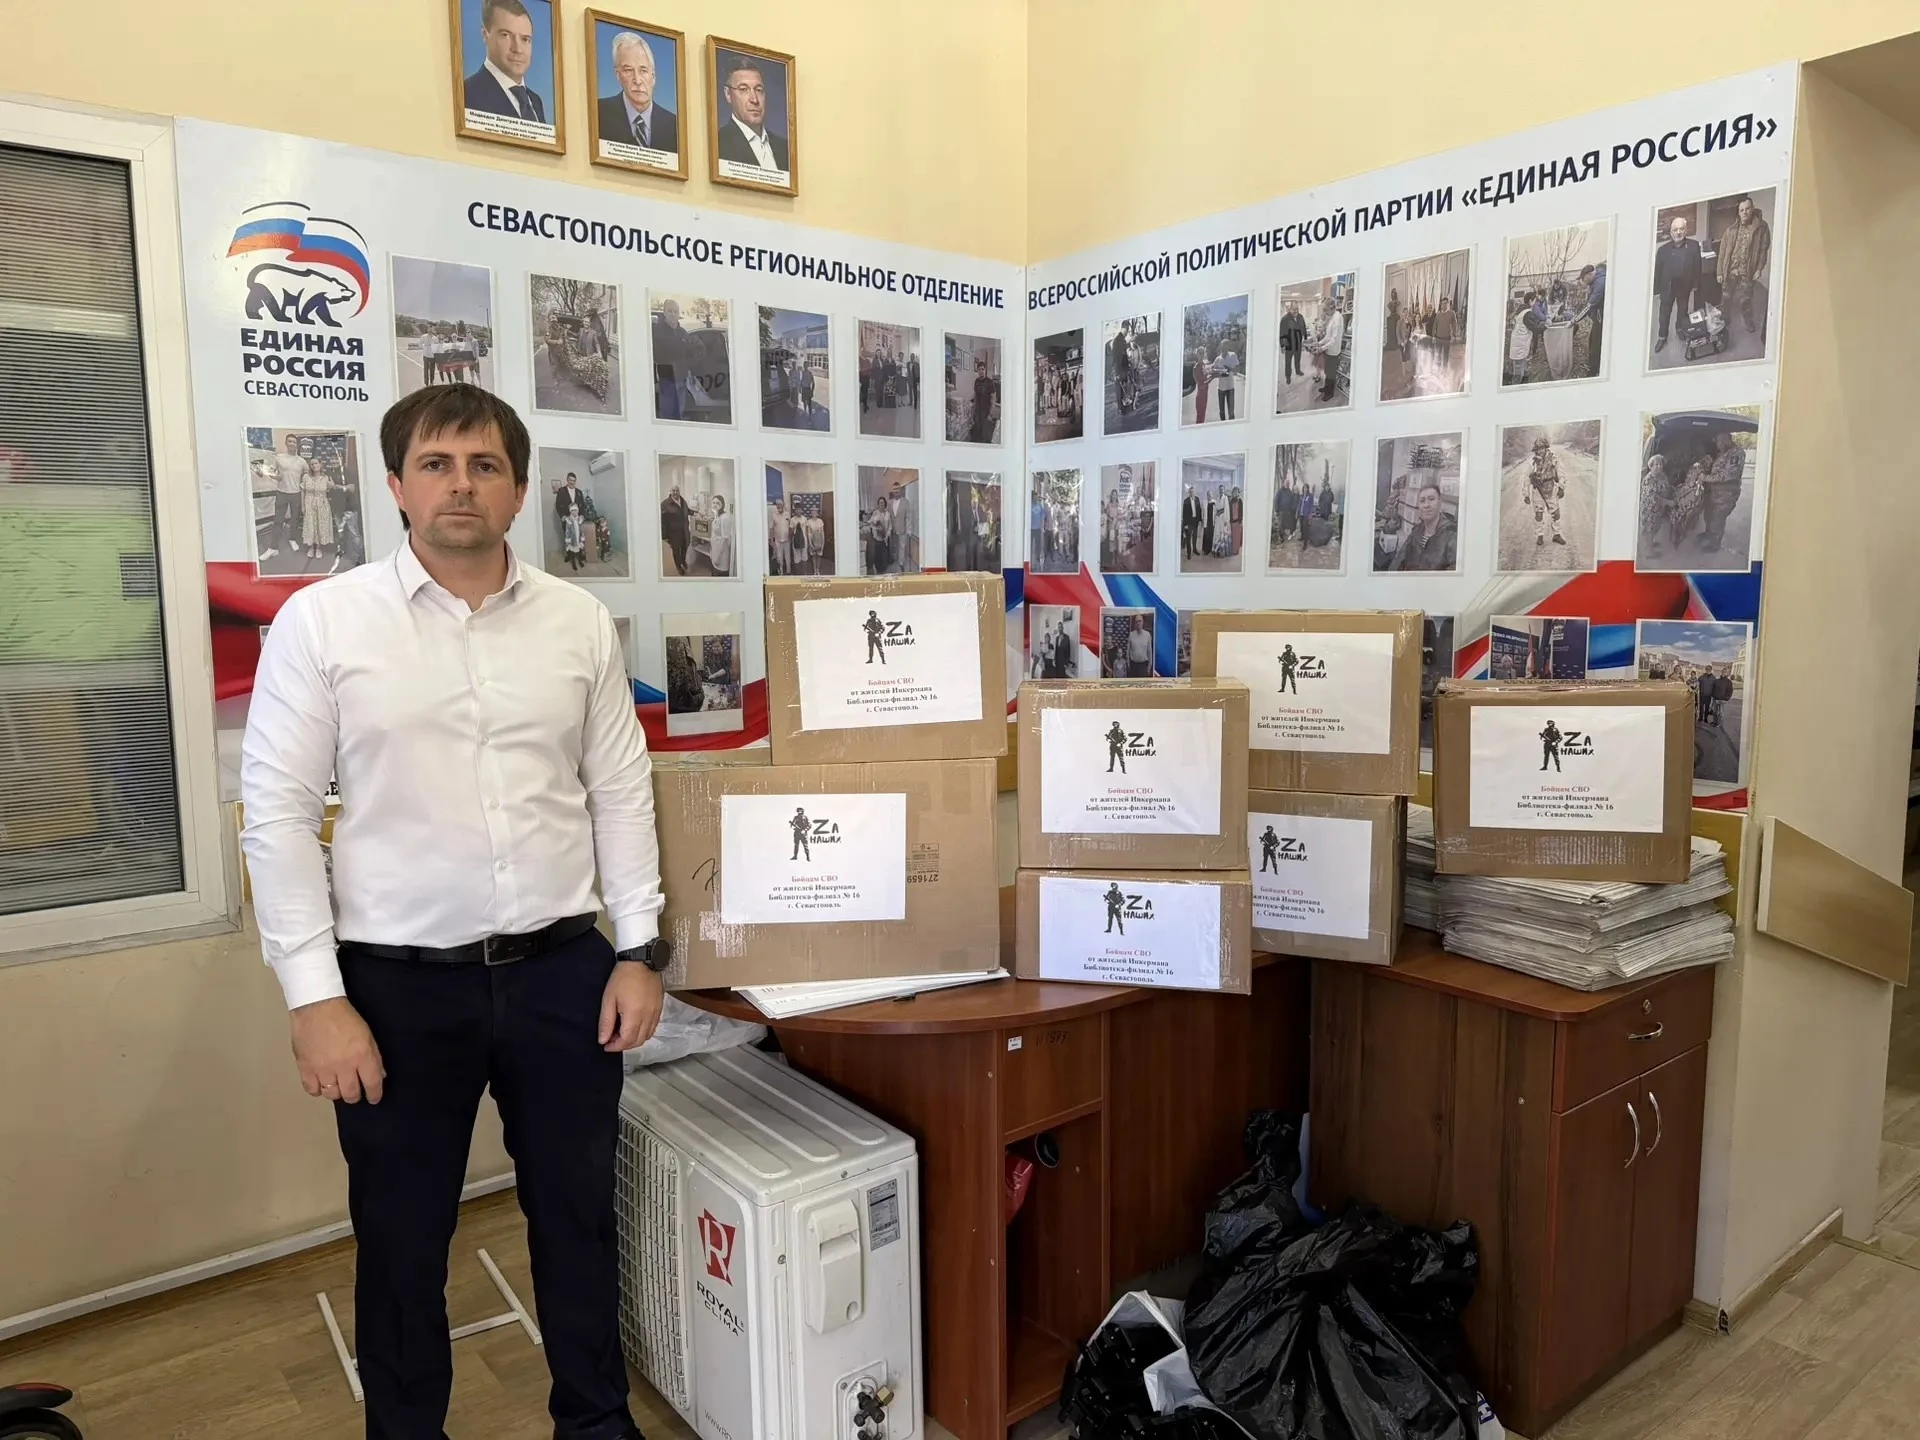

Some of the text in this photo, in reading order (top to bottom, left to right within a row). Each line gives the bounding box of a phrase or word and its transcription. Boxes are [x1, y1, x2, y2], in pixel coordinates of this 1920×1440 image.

[467, 113, 1777, 310] СЕВАСТОПОЛЬСКОЕ РЕГИОНАЛЬНОЕ ОТДЕЛЕНИЕ ВСЕРОССИЙСКОЙ ПОЛИТИЧЕСКОЙ ПАРТИИ «ЕДИНАЯ РОССИЯ»
[240, 327, 363, 357] ЕДИНАЯ
[243, 353, 365, 381] РОССИЯ
[244, 380, 369, 402] СЕВАСТОПОЛЬ
[860, 688, 890, 696] жителей
[892, 686, 932, 696] Инкермана
[847, 694, 918, 705] Библиотека-филиал
[874, 705, 919, 713] Севастополь
[1300, 716, 1340, 724] Инкермана
[1257, 723, 1325, 731] Библиотека-филиал
[1131, 796, 1170, 804] Инкермана
[1566, 794, 1609, 802] Инкермана
[1517, 802, 1593, 810] Библиотека-филиал
[907, 874, 939, 883] 271659
[815, 884, 856, 892] Инкермана
[768, 893, 840, 902] Библиотека-филиал
[1282, 896, 1320, 906] Инкермана
[795, 901, 841, 909] Севастополь
[1264, 910, 1306, 920] Севастополь
[1128, 958, 1169, 967] Инкермана
[1084, 964, 1154, 974] Библиотека-филиал
[1109, 974, 1154, 982] Севастополь
[697, 1280, 744, 1332] ROYAL
[705, 1300, 738, 1336] CLIMA
